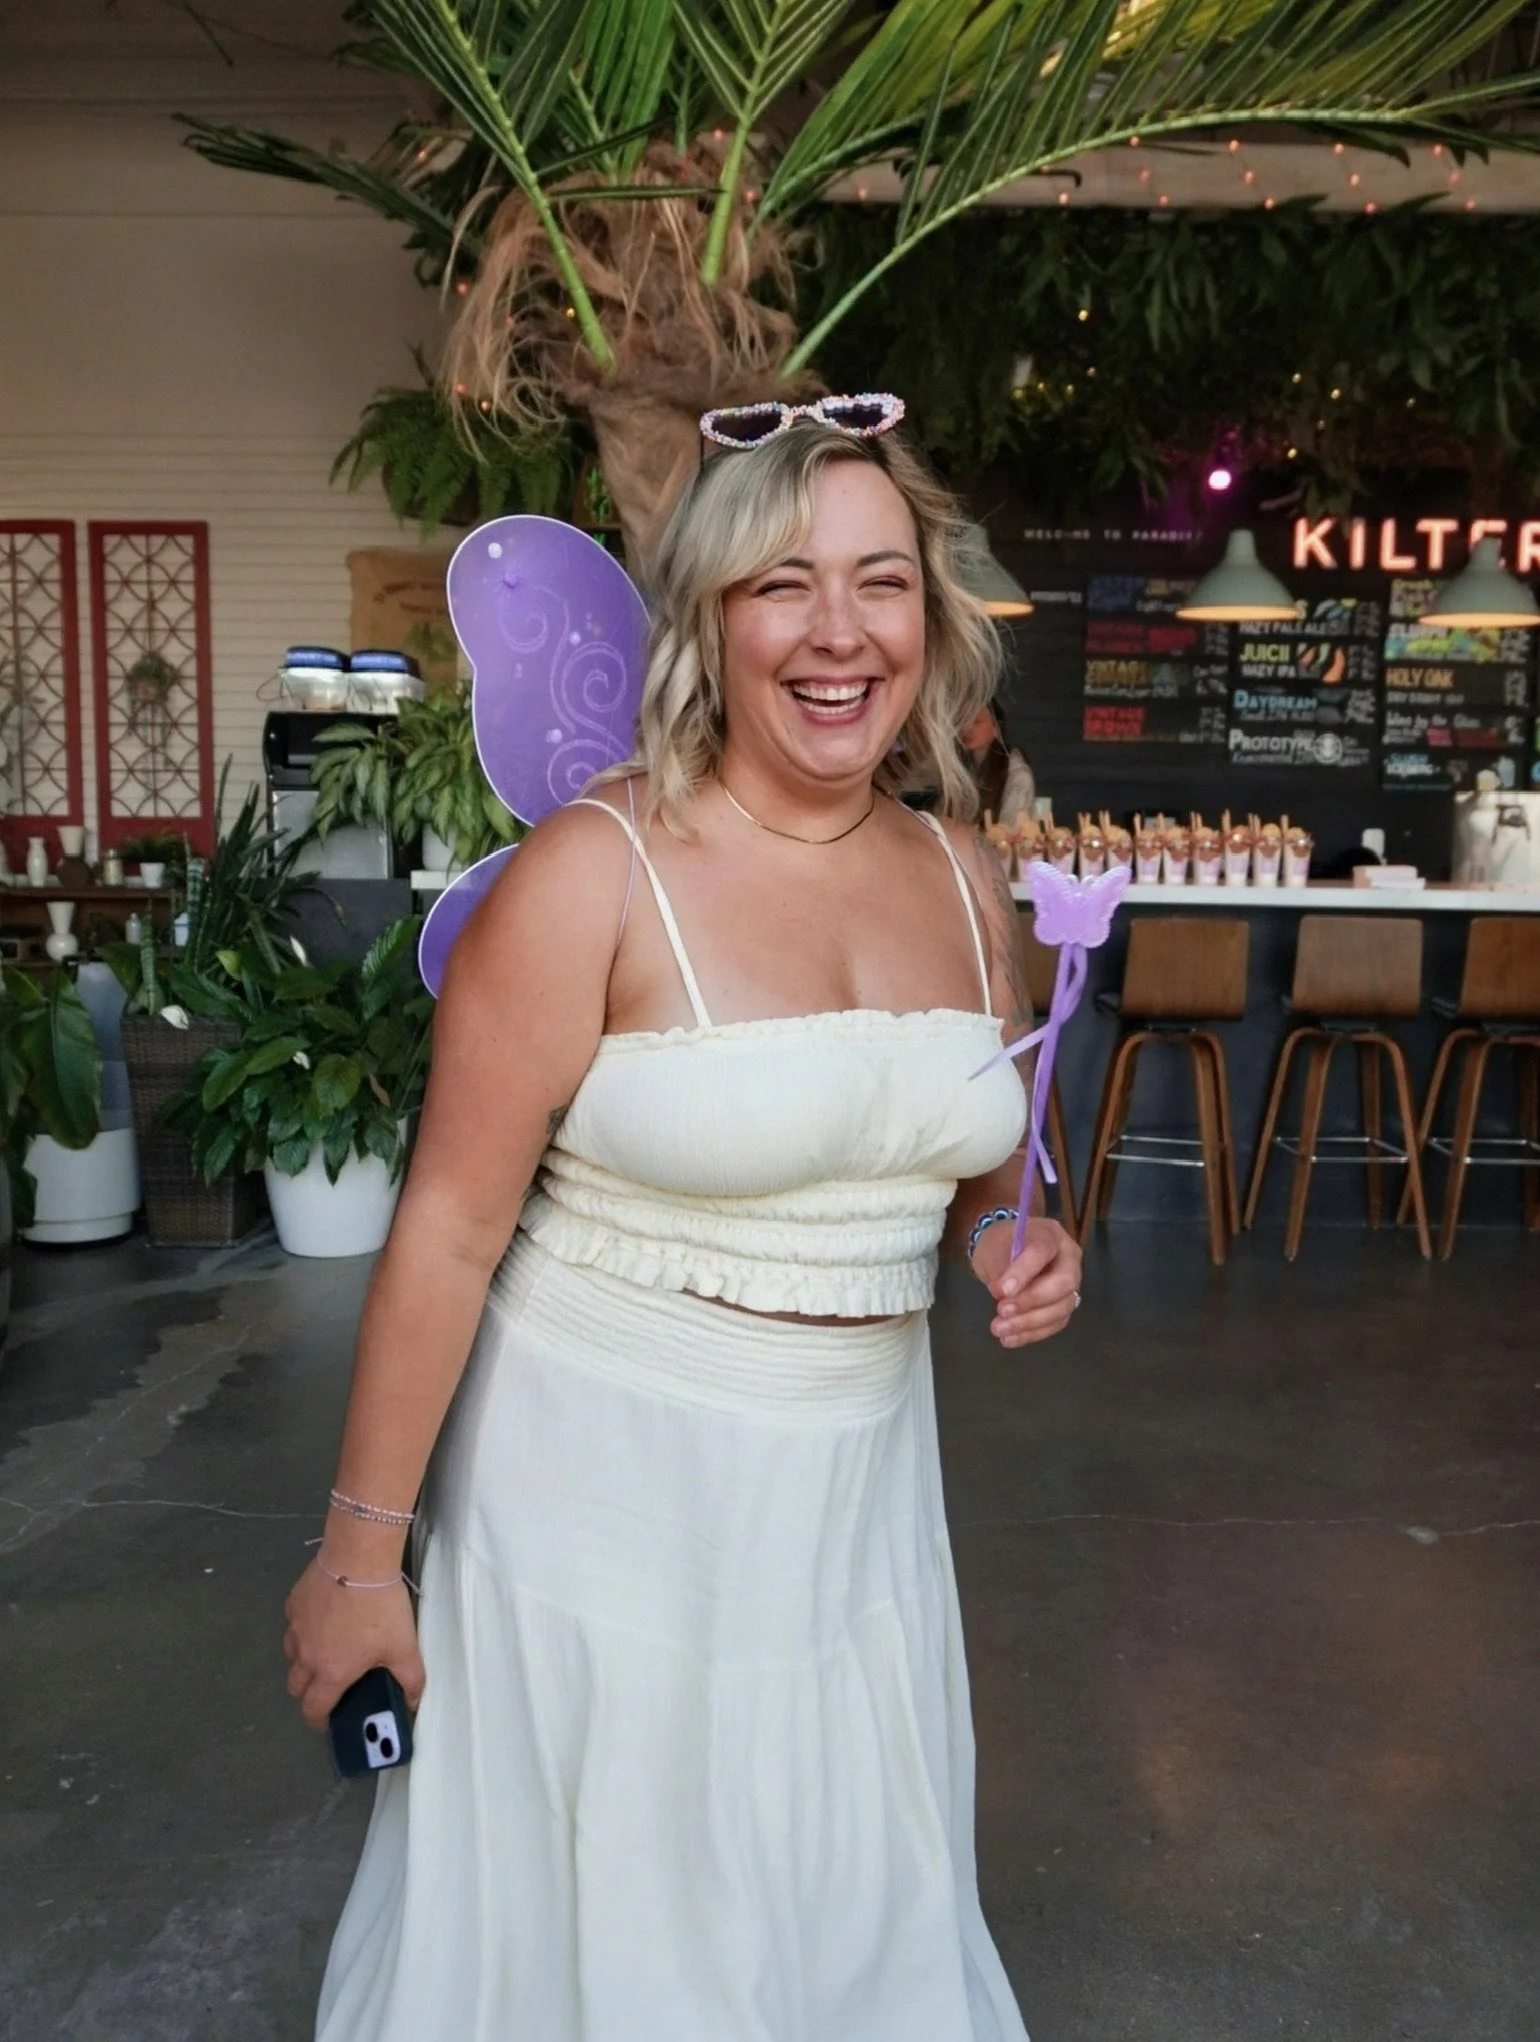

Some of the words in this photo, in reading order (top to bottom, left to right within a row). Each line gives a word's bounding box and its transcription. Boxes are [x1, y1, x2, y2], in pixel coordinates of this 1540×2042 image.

[1103, 528, 1121, 541] TO
[1277, 665, 1297, 678] IPA
[1385, 667, 1422, 688] HOLY
